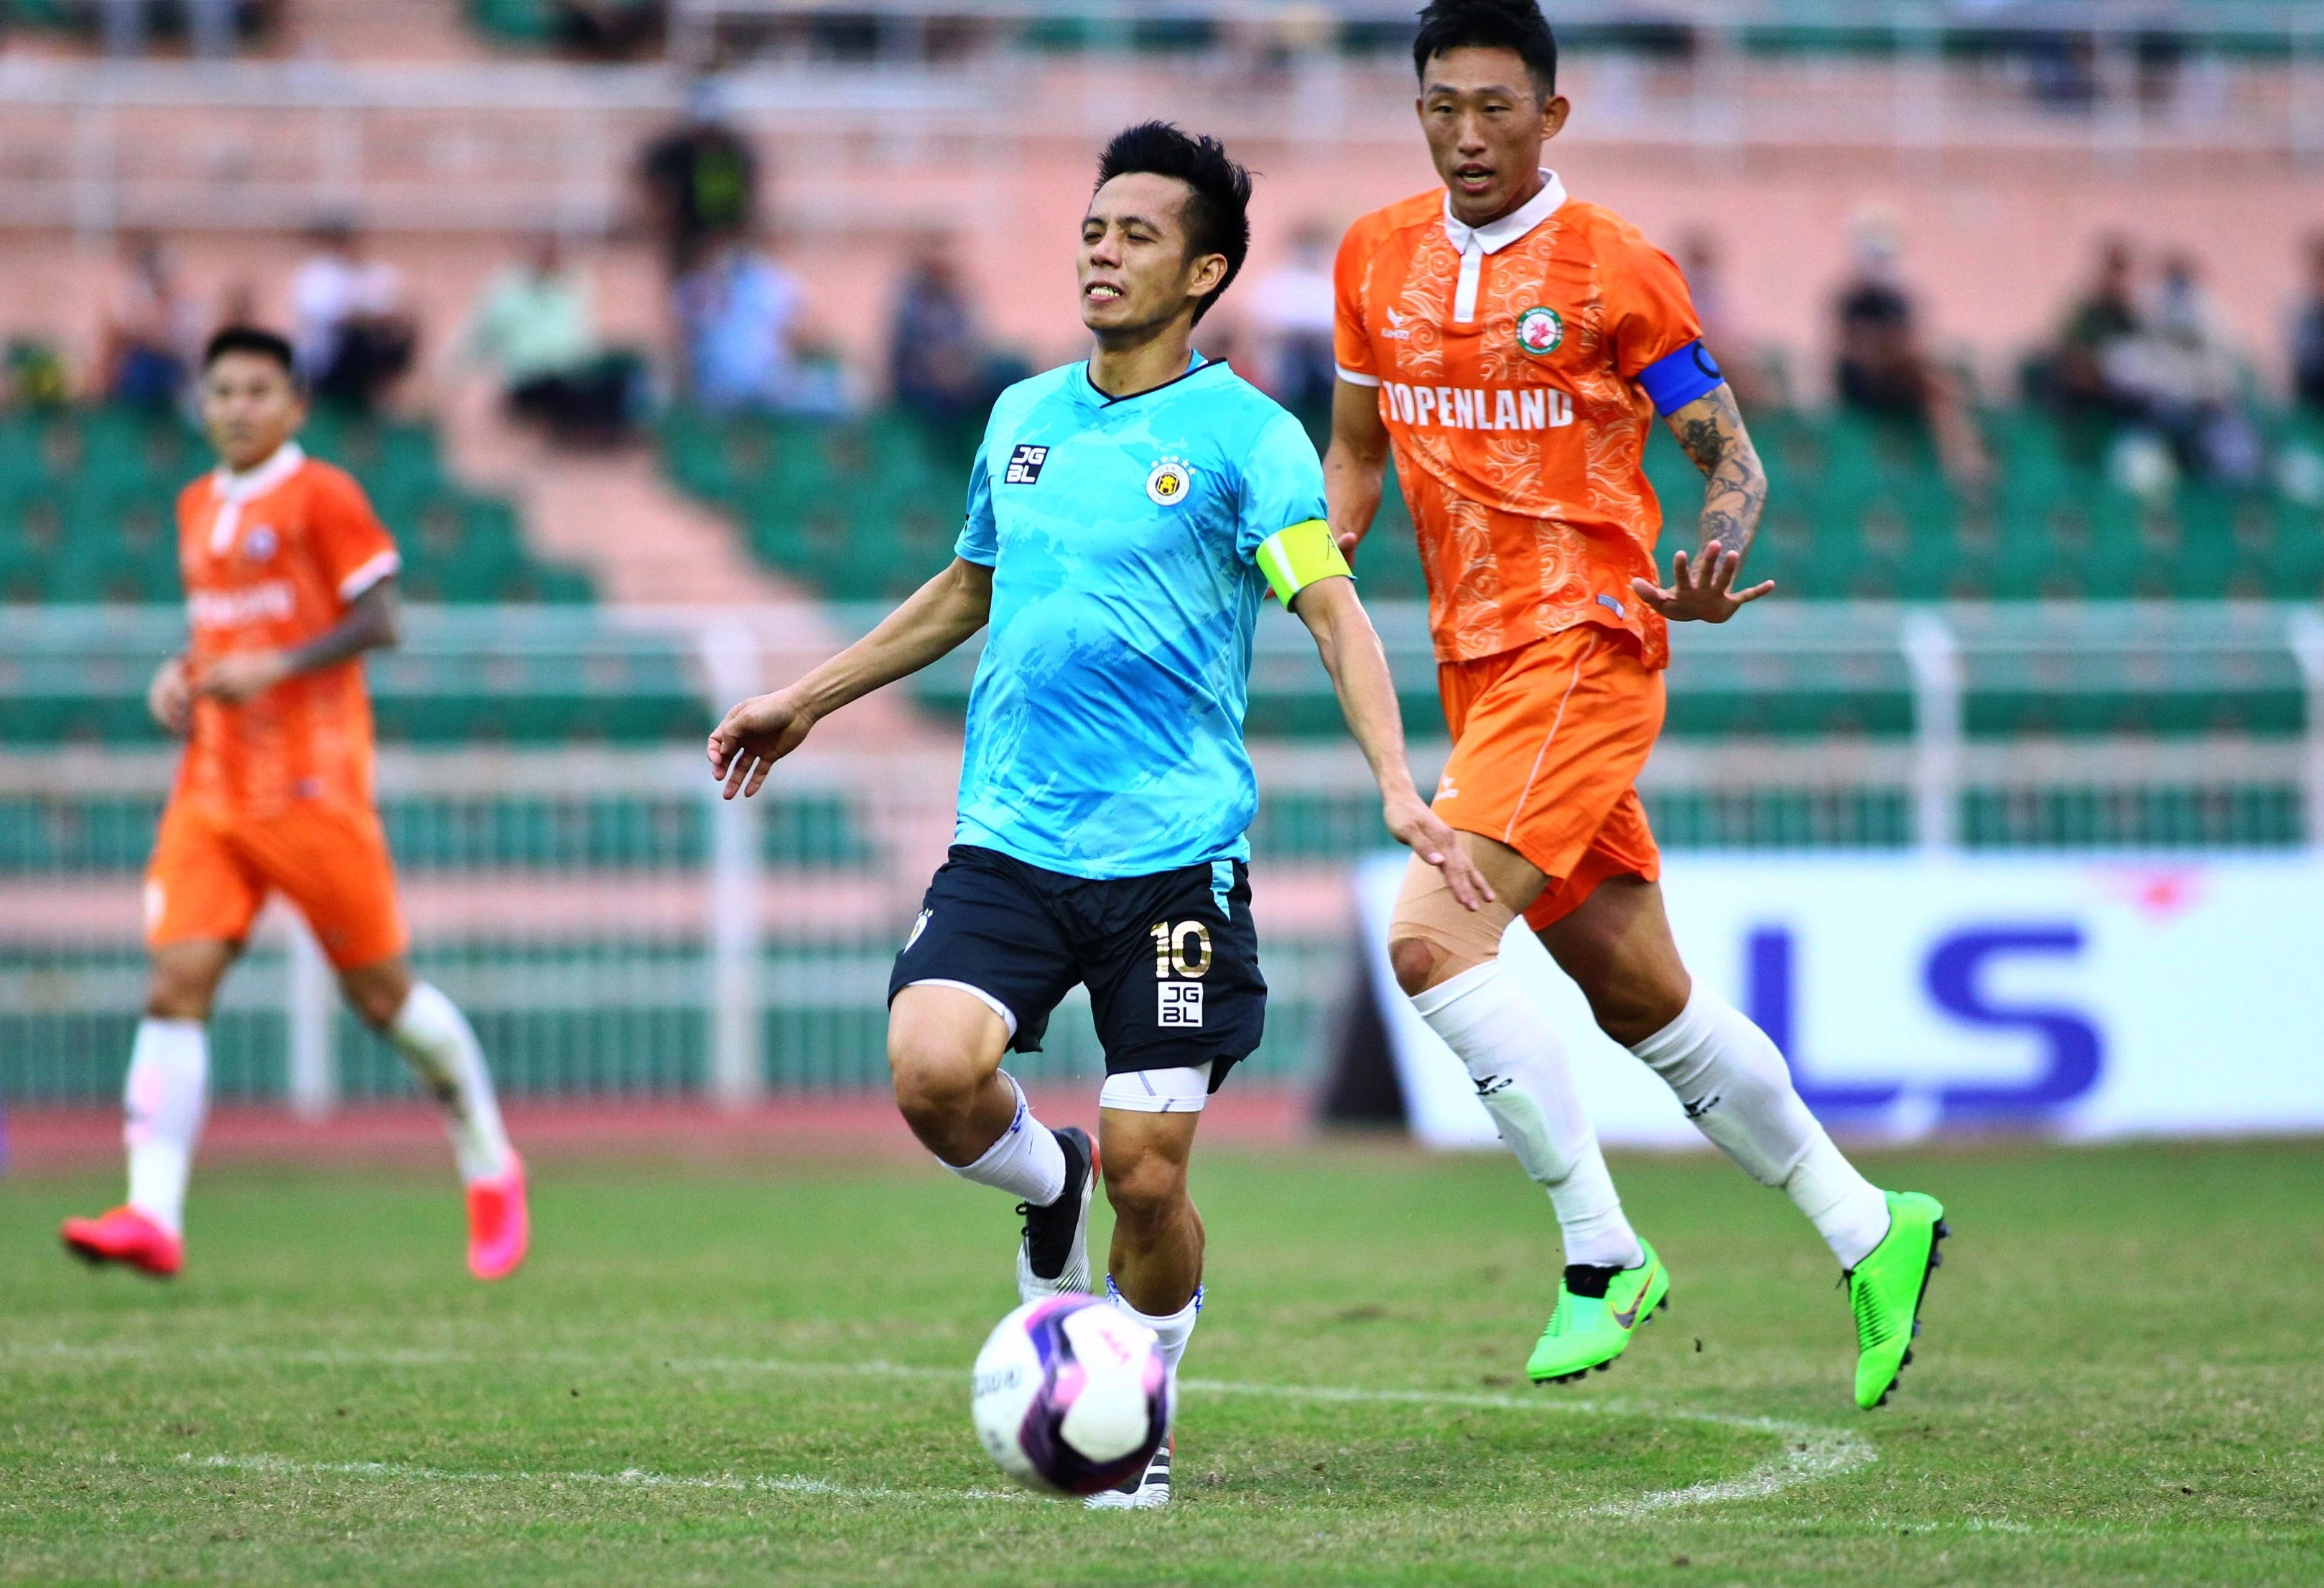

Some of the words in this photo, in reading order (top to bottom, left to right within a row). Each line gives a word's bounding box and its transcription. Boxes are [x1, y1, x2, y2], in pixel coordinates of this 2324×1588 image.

[1382, 380, 1574, 430] TOPENLAND
[1011, 446, 1046, 465] JG
[1006, 464, 1036, 483] BL
[1151, 920, 1212, 978] 10
[1163, 987, 1199, 1003] JG
[1163, 1006, 1199, 1023] BL
[1748, 924, 2104, 1106] LS
